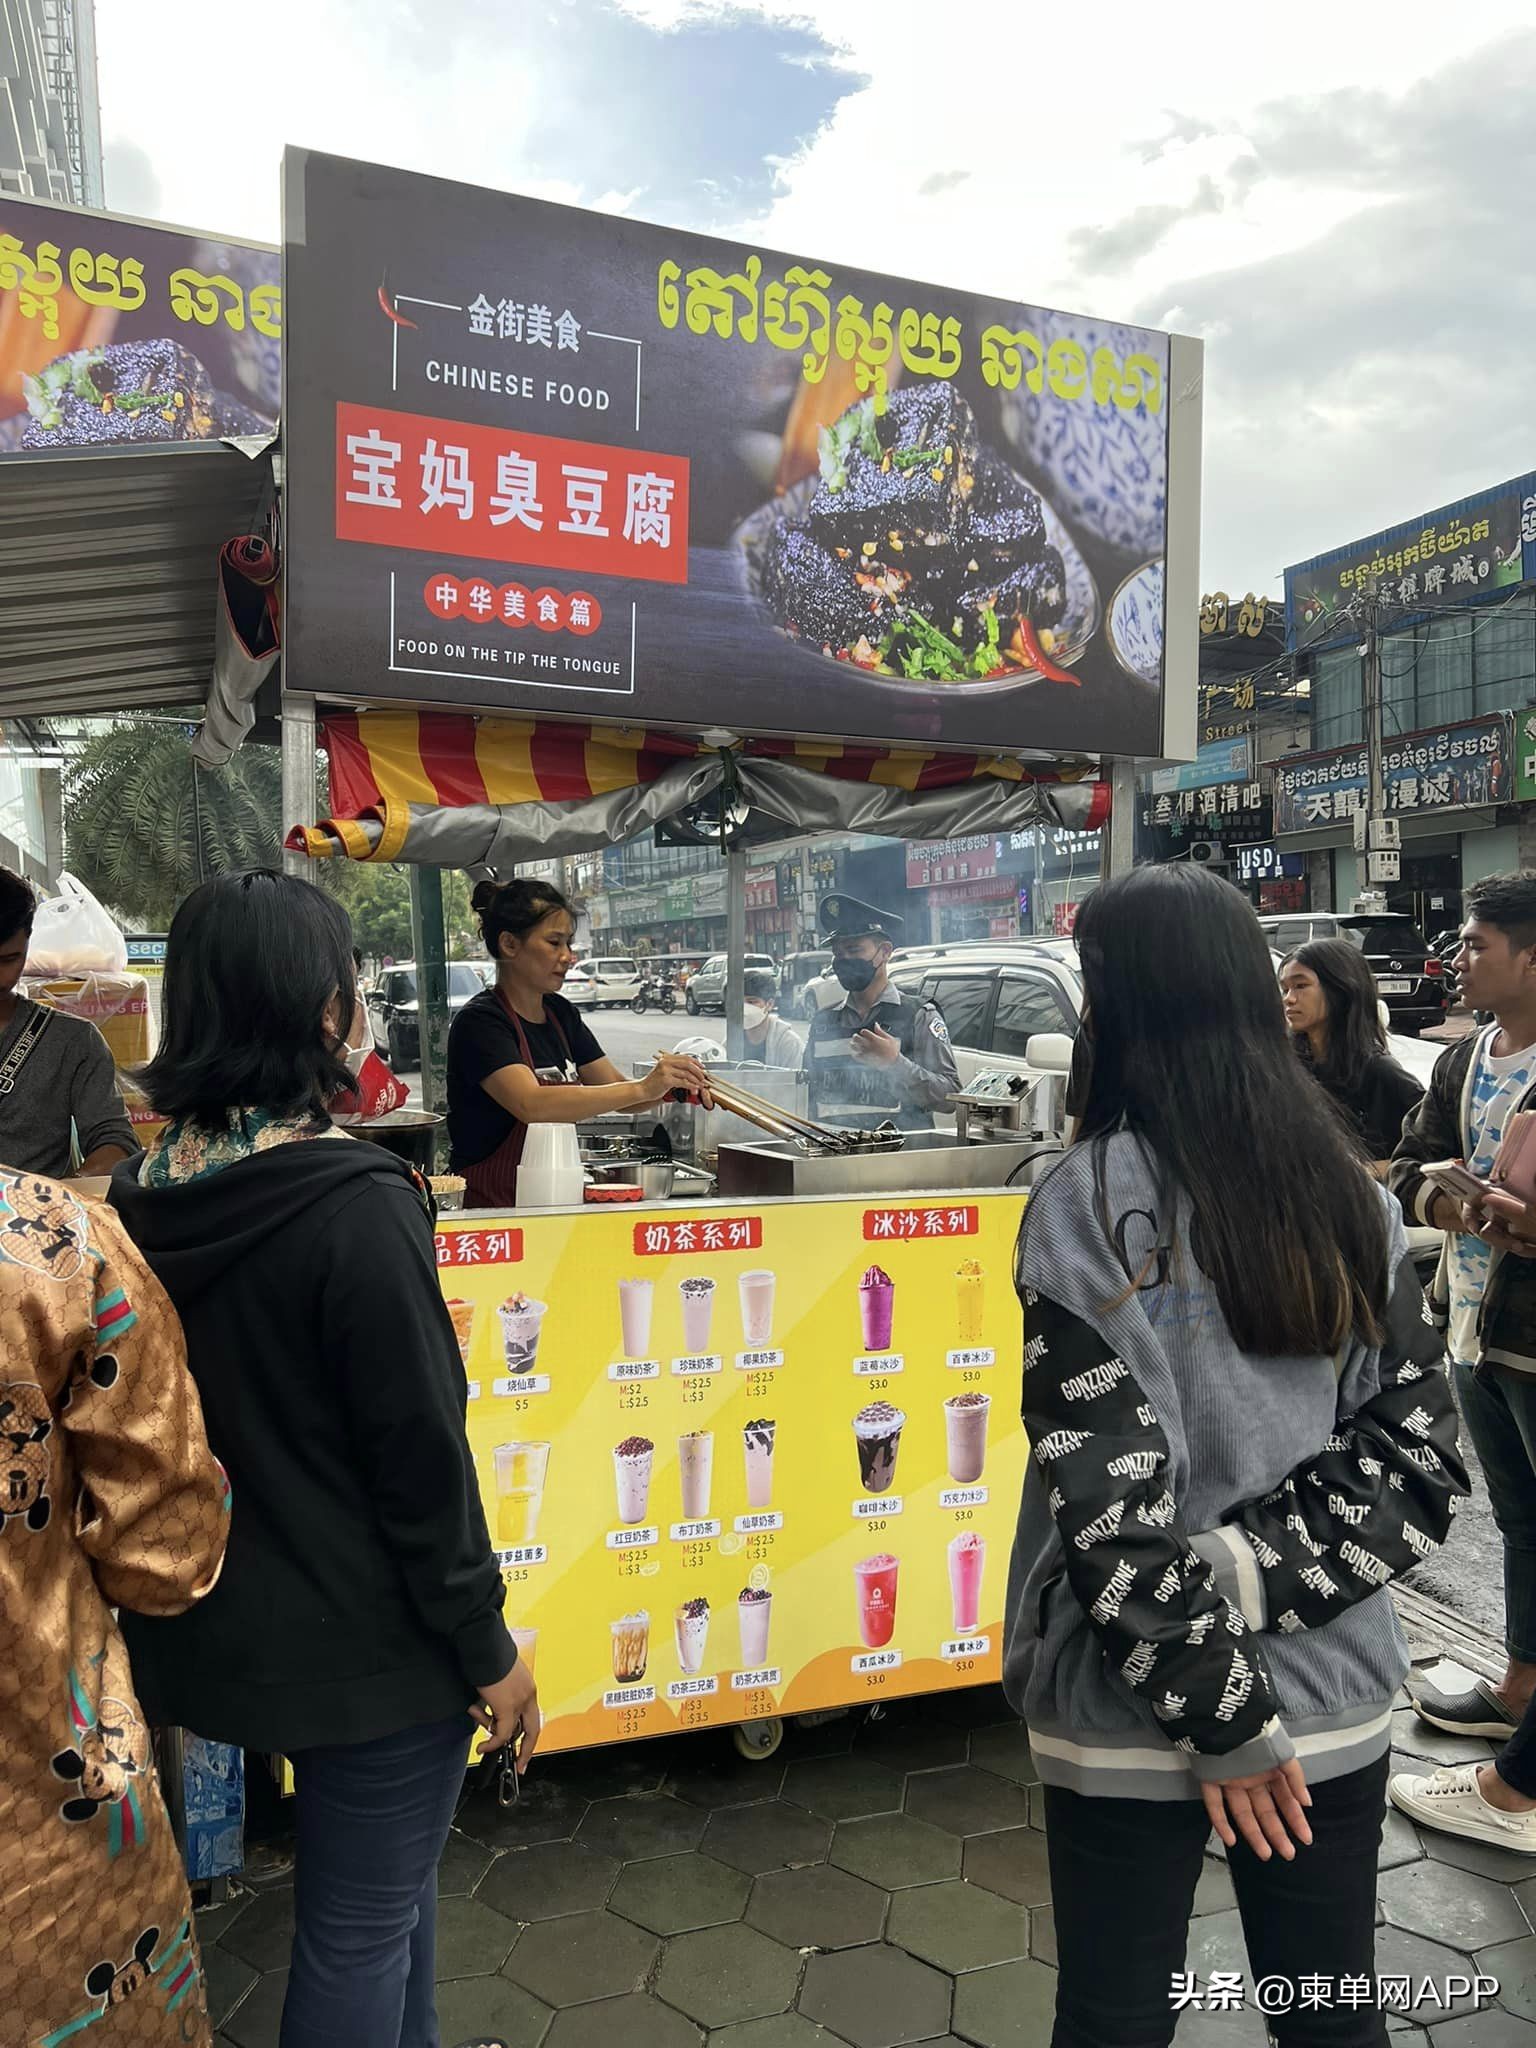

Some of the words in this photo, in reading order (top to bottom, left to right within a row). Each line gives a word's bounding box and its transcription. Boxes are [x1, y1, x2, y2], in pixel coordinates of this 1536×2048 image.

[467, 293, 582, 353] 金街美食
[426, 360, 534, 399] CHINESE
[545, 381, 610, 411] FOOD
[344, 429, 676, 549] 宝妈臭豆腐
[435, 580, 592, 628] 中华美食篇
[398, 638, 438, 656] FOOD
[444, 644, 466, 659] ON
[471, 647, 499, 663] THE
[503, 650, 526, 666] TIP
[531, 654, 558, 669] THE
[563, 657, 621, 675] TONGUE
[1205, 720, 1251, 742] Street
[873, 1208, 969, 1237] 冰沙系列
[644, 1220, 751, 1252] 奶茶系列
[679, 1357, 715, 1372] 珍珠奶茶
[952, 1351, 991, 1365] 百香冰沙
[616, 1362, 654, 1377] 原味奶茶
[507, 1377, 537, 1393] 烧仙草
[1060, 1357, 1131, 1402] GONZZONE
[858, 1501, 898, 1515] 咖啡冰沙
[678, 1523, 713, 1537] 布丁奶茶
[742, 1514, 777, 1529] 仙草奶茶
[614, 1531, 651, 1545] 红豆奶茶
[949, 1640, 985, 1655] 草莓冰沙
[858, 1654, 897, 1669] 西瓜冰沙
[605, 1687, 654, 1705] 黑糖脏脏奶茶
[671, 1678, 715, 1696] 奶茶三兄弟
